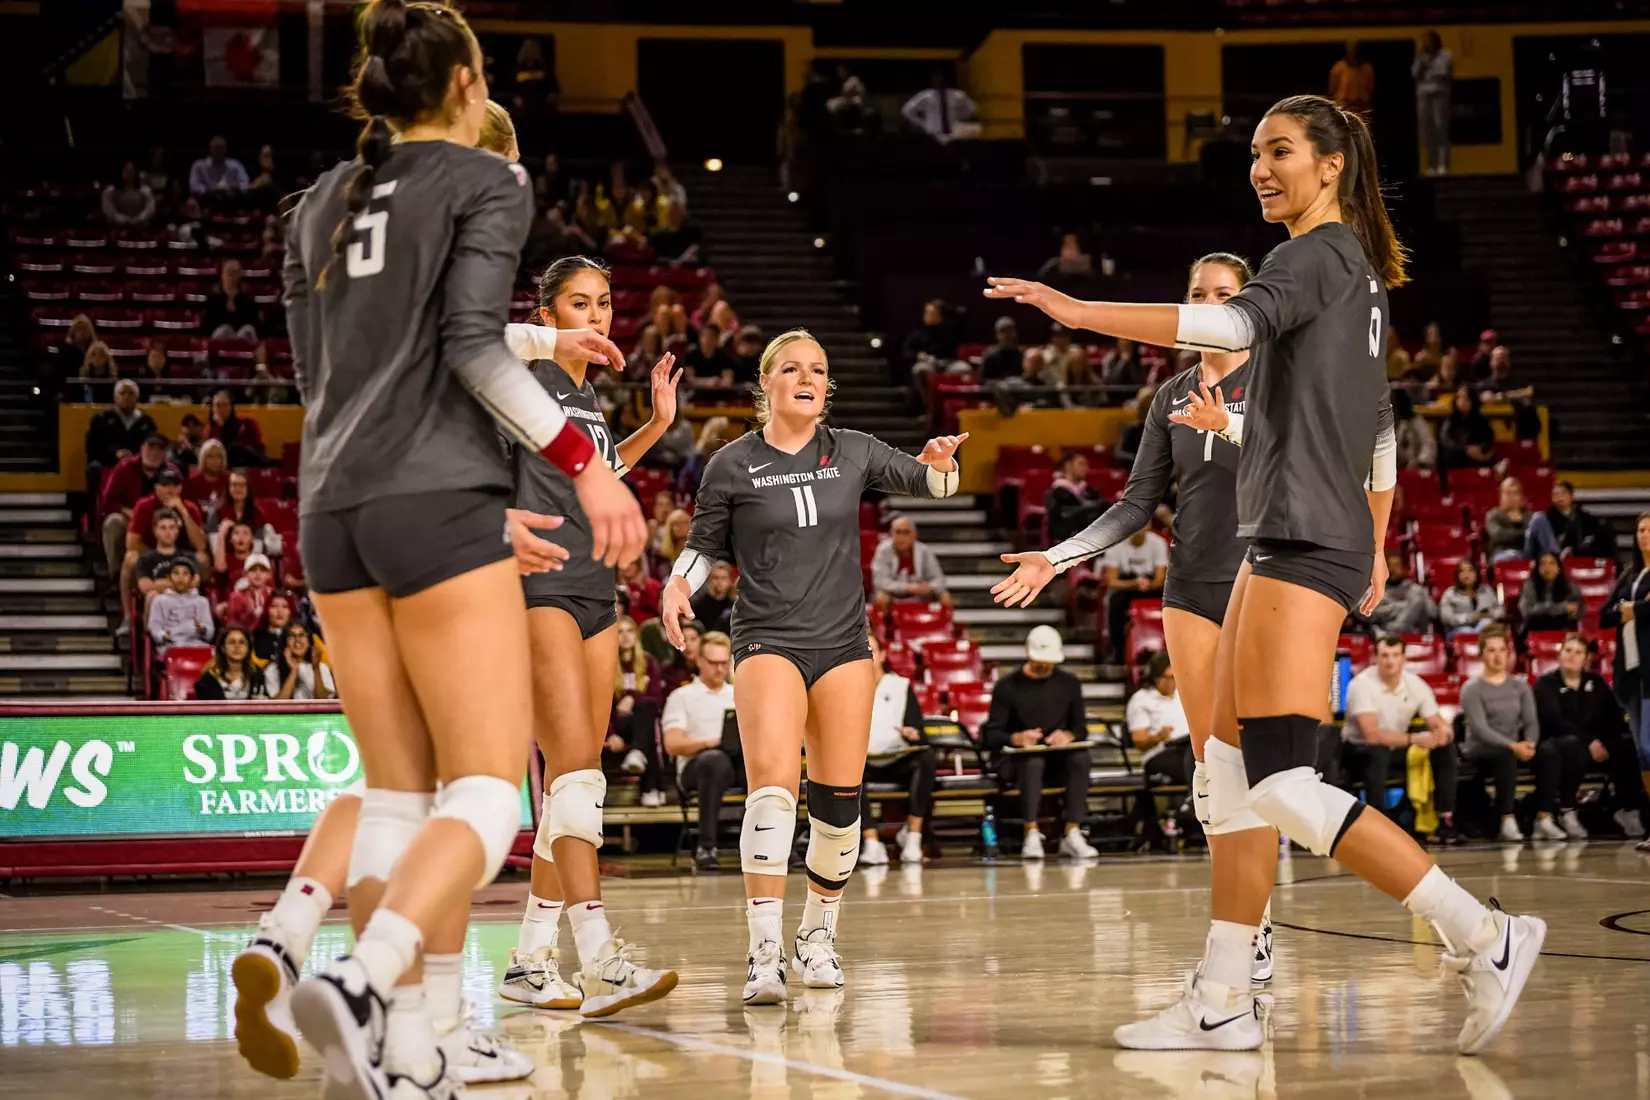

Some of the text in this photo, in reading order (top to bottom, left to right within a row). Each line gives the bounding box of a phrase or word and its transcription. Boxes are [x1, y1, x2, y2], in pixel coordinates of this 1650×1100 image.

[346, 180, 398, 278] 5
[586, 423, 612, 469] 12
[752, 466, 841, 489] WASHINGTON STATE
[789, 485, 818, 528] 11
